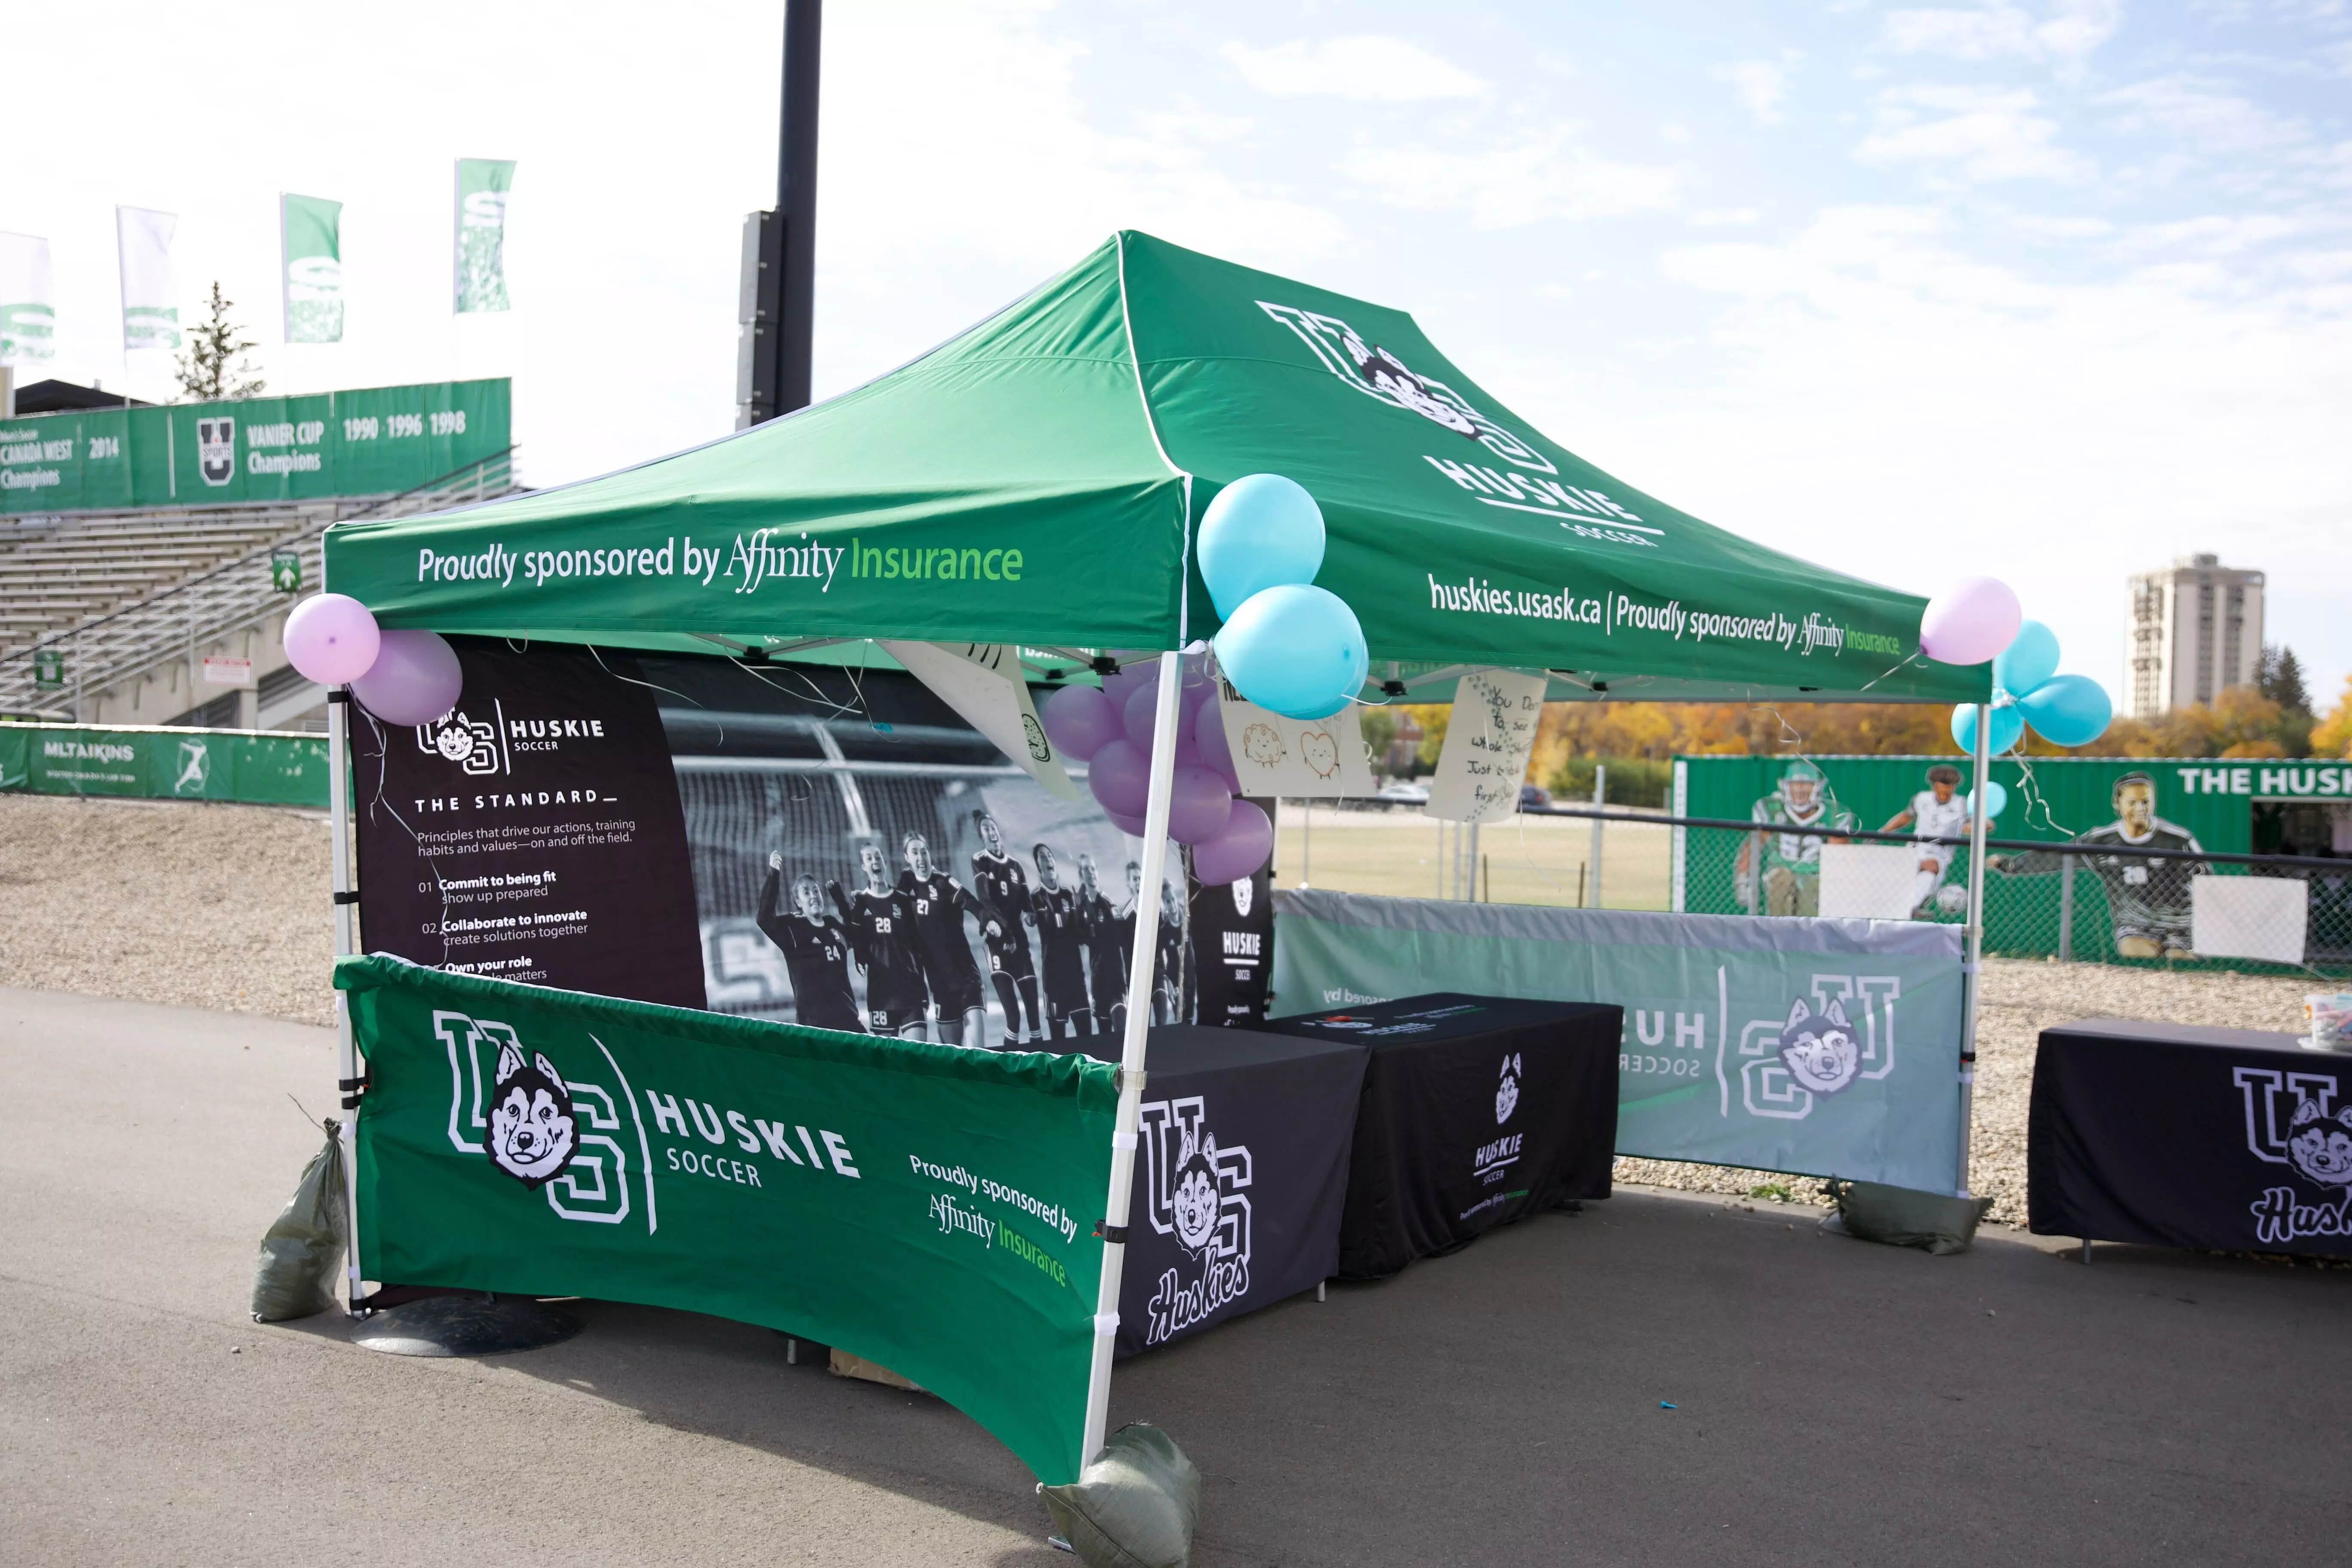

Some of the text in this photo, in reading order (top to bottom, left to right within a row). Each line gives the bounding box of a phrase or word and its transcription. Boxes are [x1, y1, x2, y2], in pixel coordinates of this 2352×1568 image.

[246, 420, 324, 448] VANIER CUP
[343, 410, 466, 441] 1990 1996 1998
[0, 438, 74, 466] CANADA WEST
[89, 436, 119, 459] 2014
[202, 447, 233, 458] SPORTS
[247, 448, 321, 478] Champions
[0, 466, 60, 493] Champions
[1423, 455, 1643, 522] HUSKIE
[1560, 522, 1659, 547] SOCCER
[419, 528, 1023, 594] Proudly sponsored by Affinity Insurance
[1428, 573, 1901, 656] huskies.usask.ca Proudly sponsored by Affinity Insurance
[1491, 685, 1512, 709] You
[510, 720, 604, 738] HUSKIE
[1493, 711, 1528, 731] to see
[514, 741, 559, 751] SOCCER
[1472, 736, 1503, 752] whole
[1467, 760, 1492, 775] Just
[1475, 784, 1498, 801] first
[2177, 768, 2252, 794] THE
[415, 797, 459, 813] THE
[418, 819, 635, 843] Principles that drive our actions, training
[418, 843, 454, 857] habits
[457, 842, 479, 853] and
[548, 836, 568, 847] and
[571, 834, 585, 845] off
[588, 833, 605, 844] the
[608, 832, 633, 843] field.
[1779, 832, 1822, 863] 52
[419, 870, 557, 893] 01 Commit to being fit
[1000, 881, 1008, 896] 9
[442, 885, 548, 904] show up prepared
[916, 898, 929, 915] 27
[422, 910, 588, 934] 02 Collaborate to innovate
[875, 917, 891, 933] 28
[444, 924, 588, 946] create solutions together
[1223, 931, 1261, 956] HUSKIE
[445, 956, 532, 974] Own your role
[824, 945, 841, 961] 24
[992, 955, 1001, 970] 9
[505, 969, 547, 982] matters
[873, 1011, 888, 1026] 28
[645, 1088, 861, 1179] HUSKIE
[1475, 1133, 1523, 1167] HUSKIE
[667, 1146, 763, 1188] SOCCER
[909, 1155, 1077, 1243] Proudly sponsored by
[928, 1193, 1066, 1287] Affinity Insurance
[1146, 1246, 1249, 1345] Huskies
